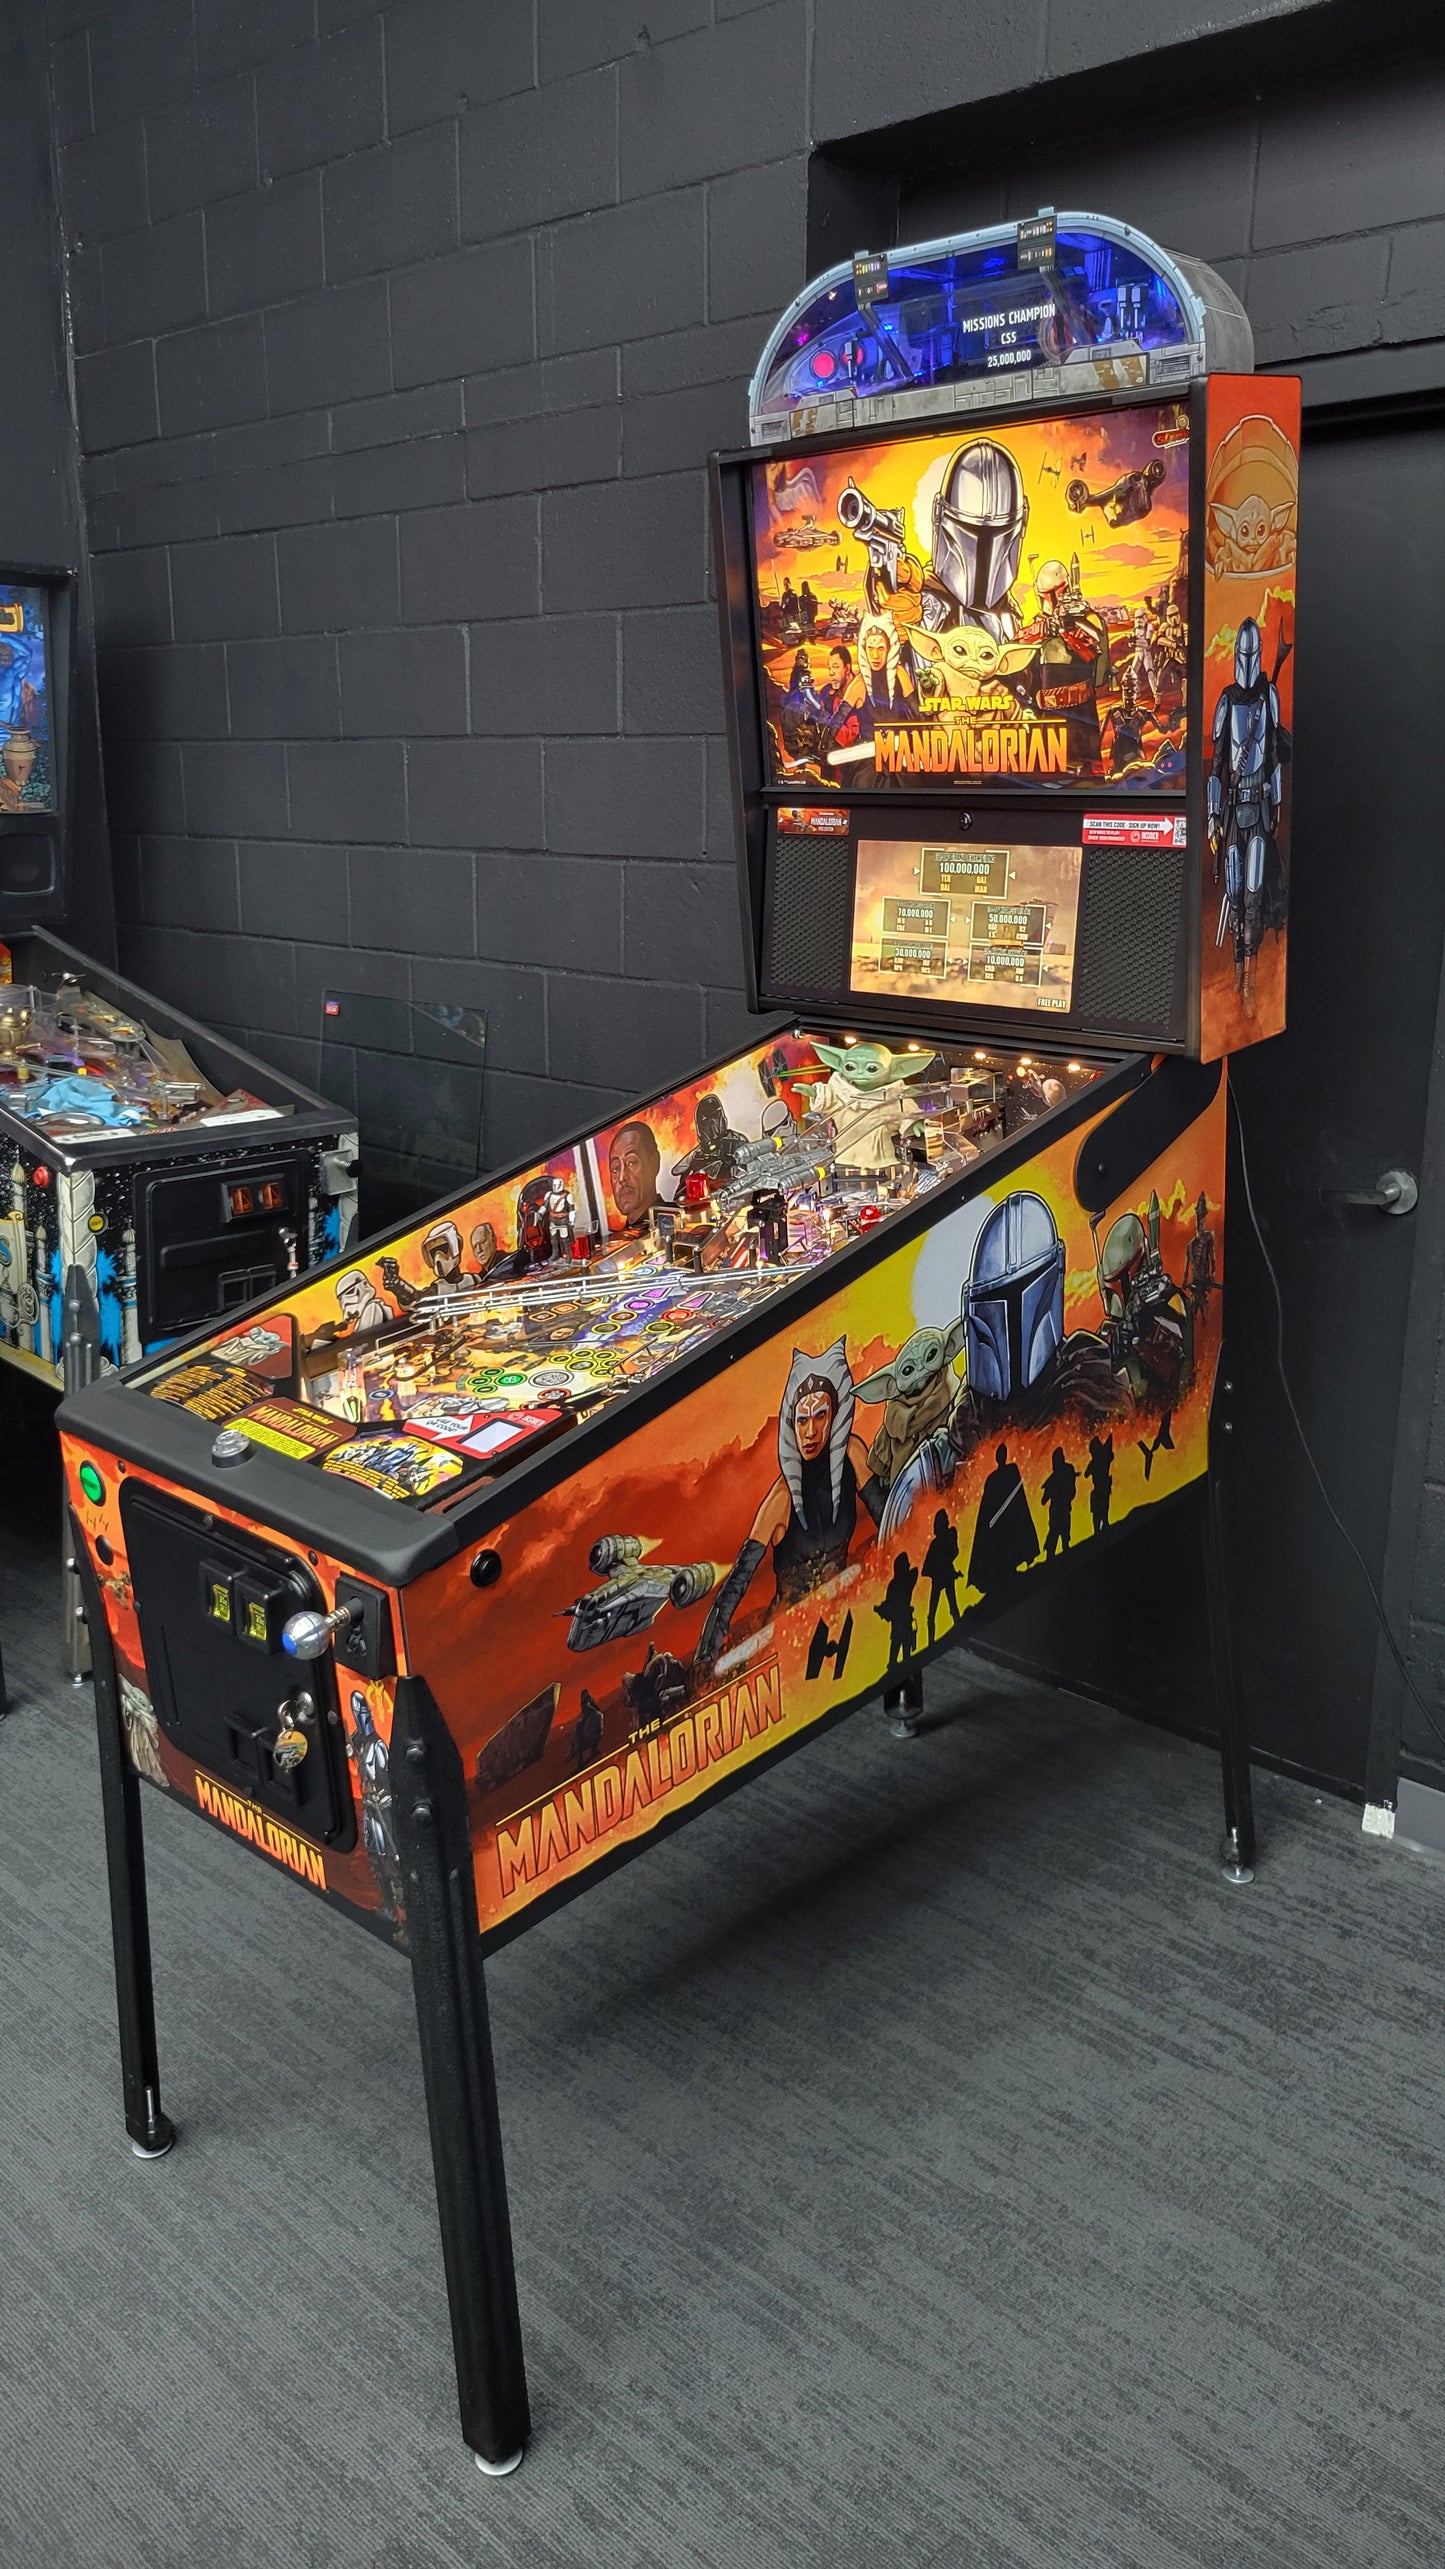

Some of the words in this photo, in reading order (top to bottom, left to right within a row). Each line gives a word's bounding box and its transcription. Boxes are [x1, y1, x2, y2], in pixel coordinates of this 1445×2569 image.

[962, 312, 1006, 334] MISSIONS
[1008, 303, 1056, 325] CHAMPION
[1001, 331, 1017, 345] CSS
[987, 349, 1032, 368] 25,000,000
[918, 697, 966, 712] STAR
[966, 694, 1014, 711] WARS
[954, 716, 977, 725] THE
[873, 727, 1068, 773] MANDALORIAN
[1089, 820, 1102, 828] SCAN
[1113, 821, 1126, 829] CODE
[940, 862, 990, 876] 100,000,000
[1037, 997, 1052, 1007] FREE
[1051, 999, 1066, 1009] PLAY
[247, 1405, 340, 1448] MANDALORIAN
[628, 1717, 662, 1745] THE
[496, 1662, 784, 1899] MANDALORIAN
[246, 1799, 263, 1814] THE
[195, 1775, 328, 1891] MANDALORIAN
